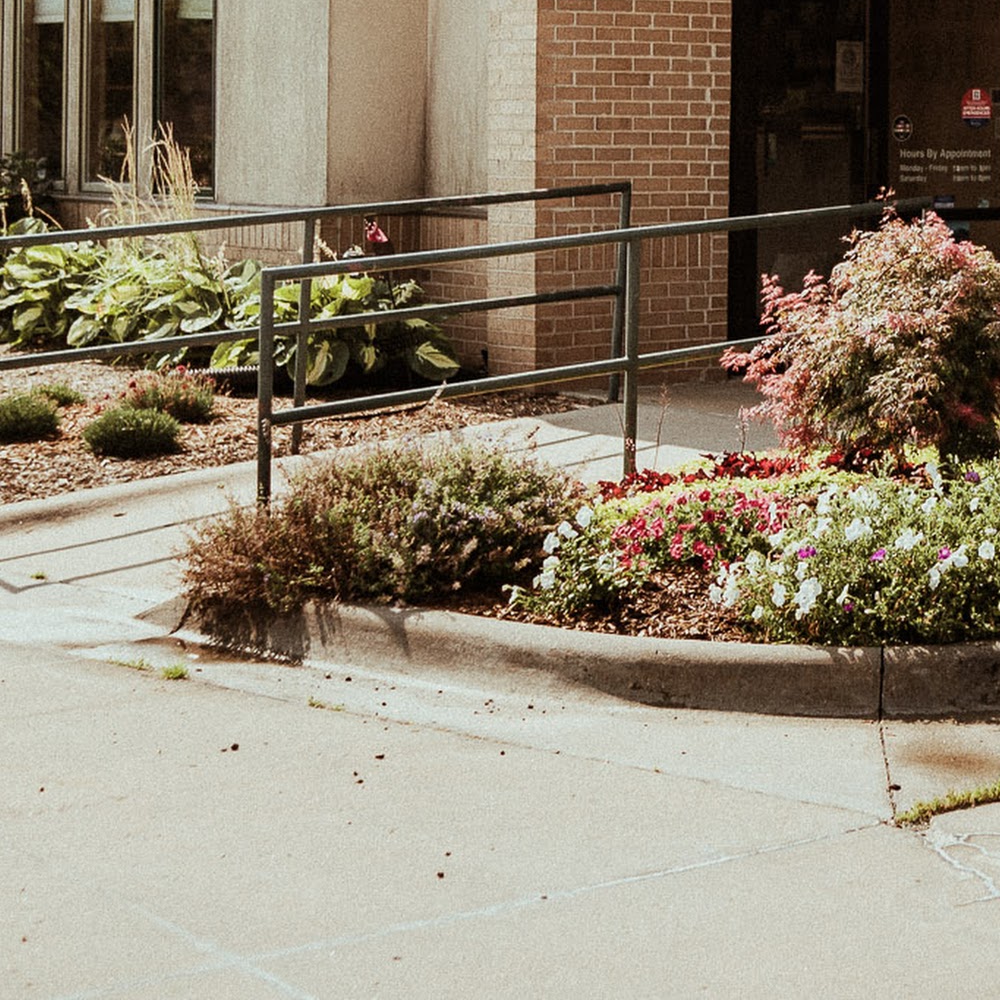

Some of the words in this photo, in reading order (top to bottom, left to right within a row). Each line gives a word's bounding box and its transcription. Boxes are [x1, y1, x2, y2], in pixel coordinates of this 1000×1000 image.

[900, 149, 925, 159] Hours
[926, 148, 938, 160] By
[940, 149, 992, 160] Appointment
